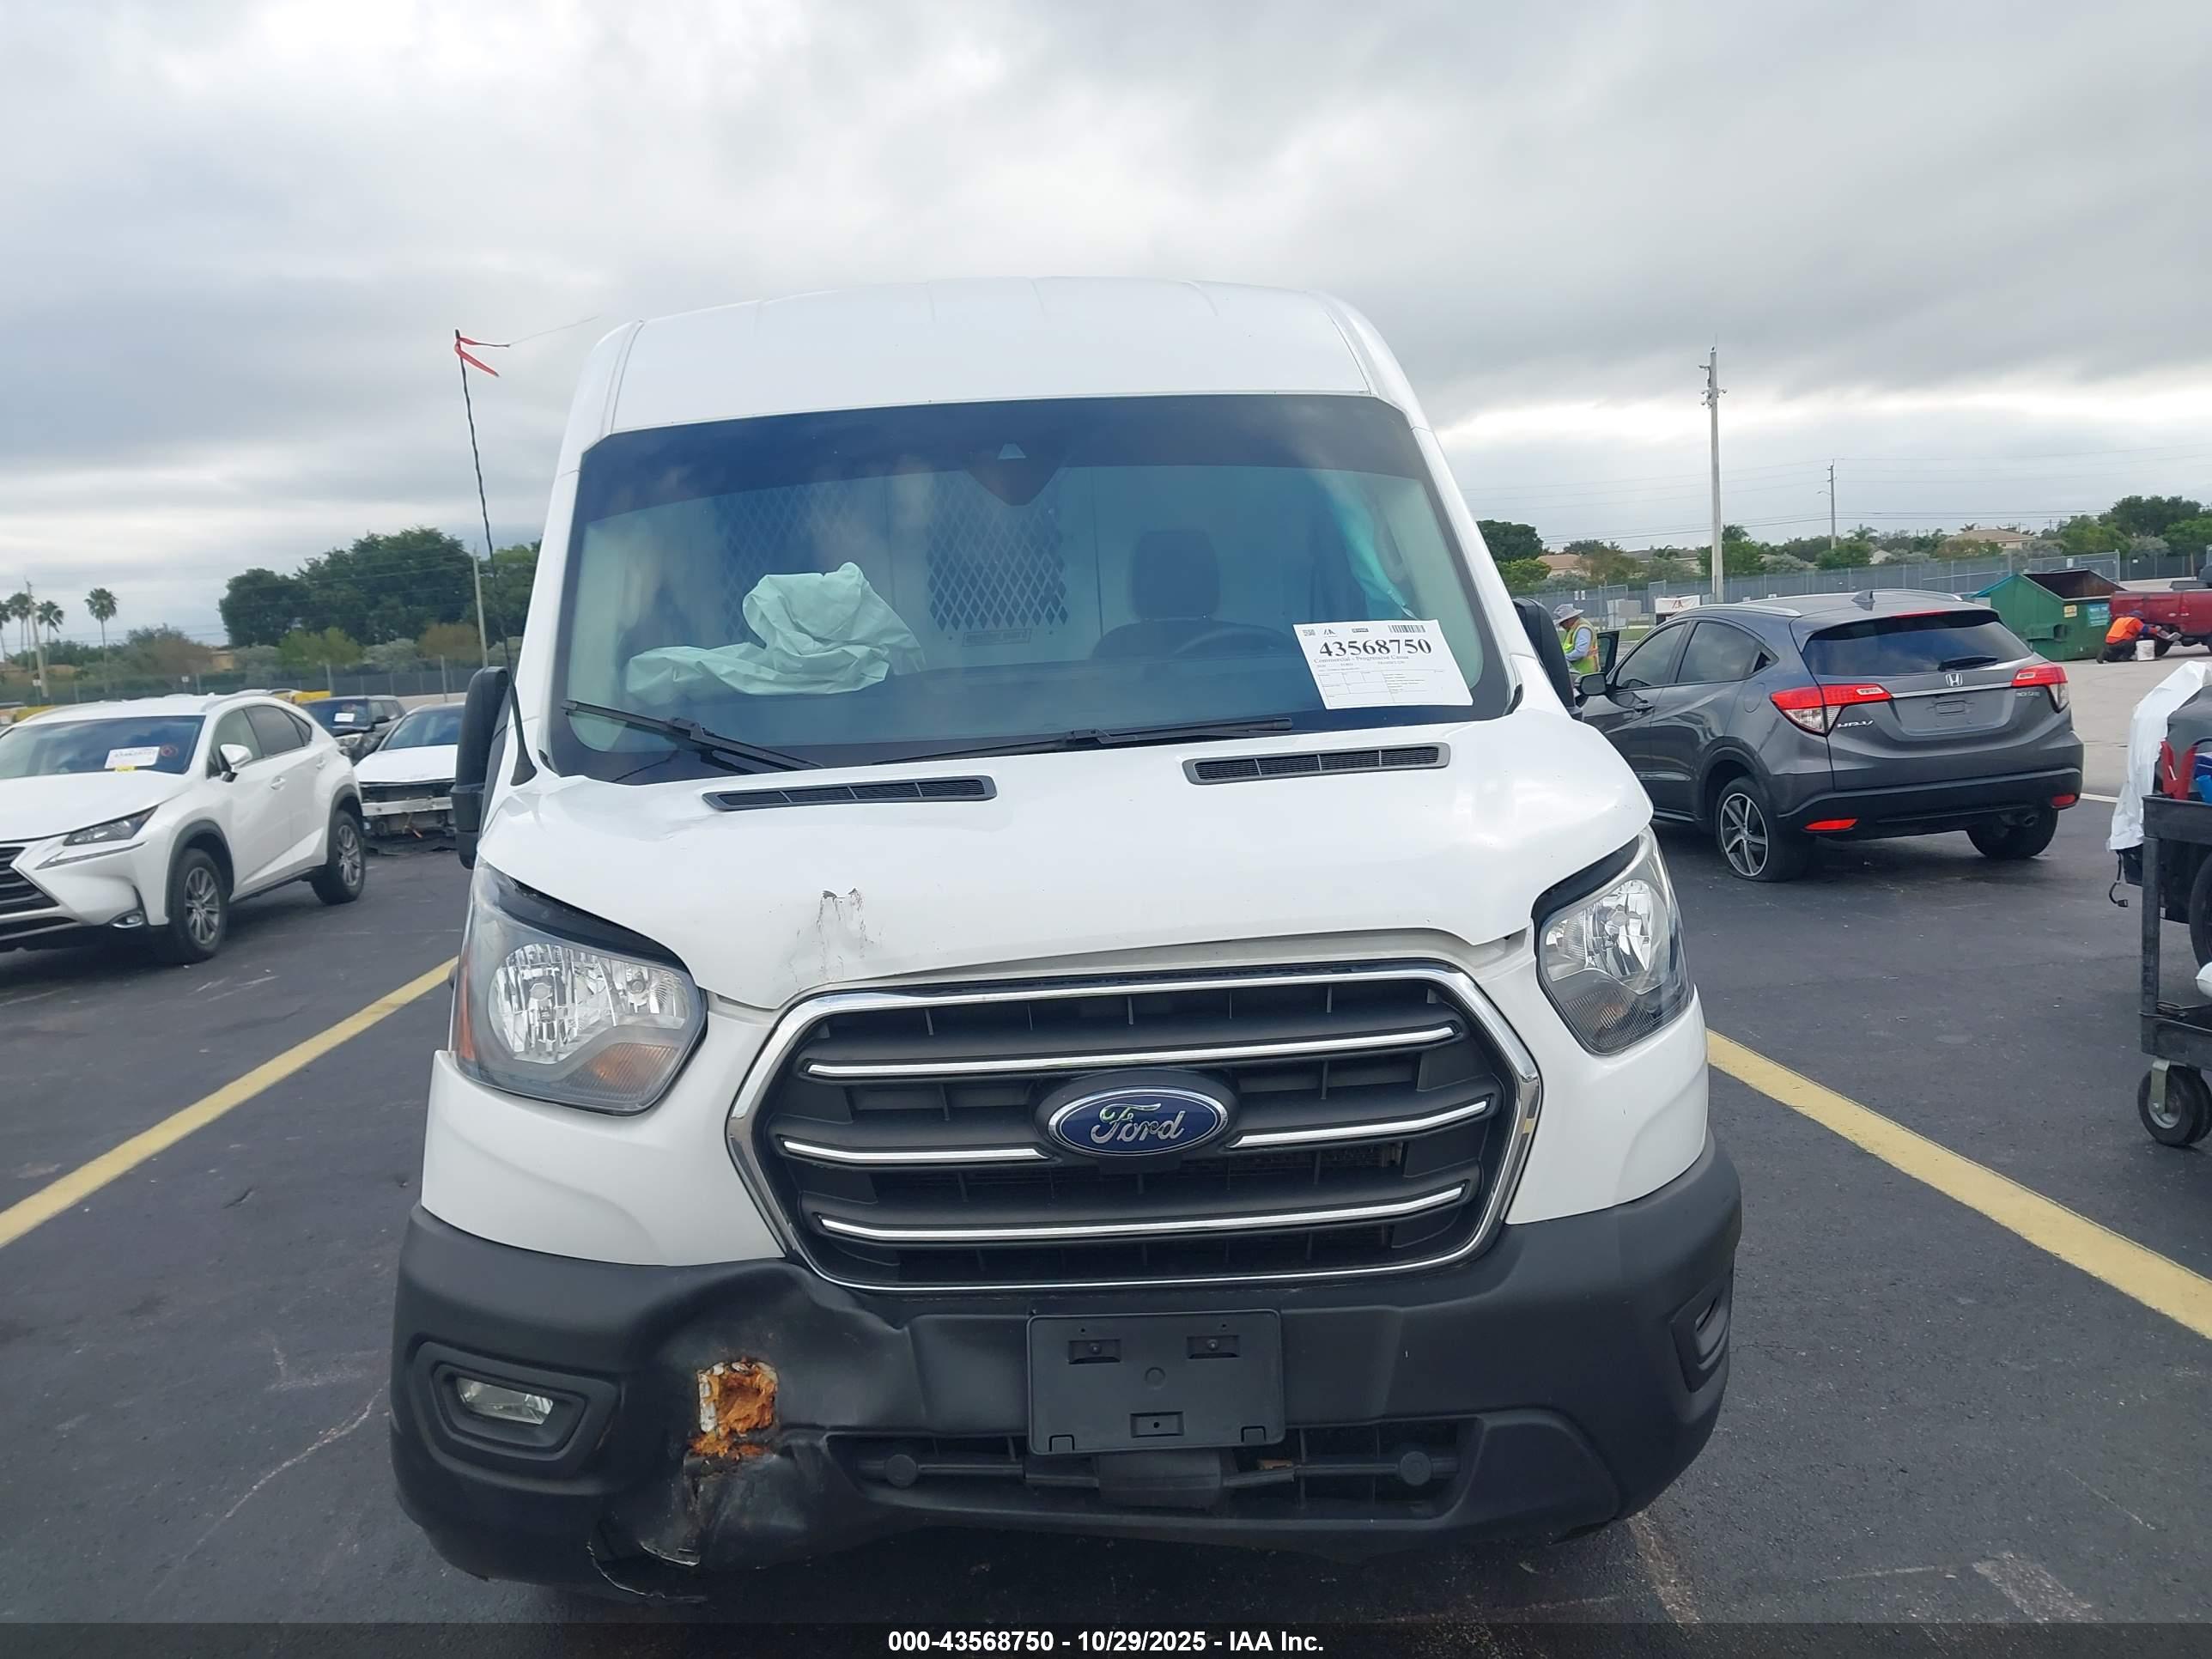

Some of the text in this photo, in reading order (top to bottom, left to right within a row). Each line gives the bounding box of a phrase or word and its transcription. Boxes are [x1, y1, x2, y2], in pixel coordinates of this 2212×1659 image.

[1319, 638, 1432, 657] 43568750
[1314, 655, 1351, 664] Commercial
[1090, 1103, 1186, 1145] Ford
